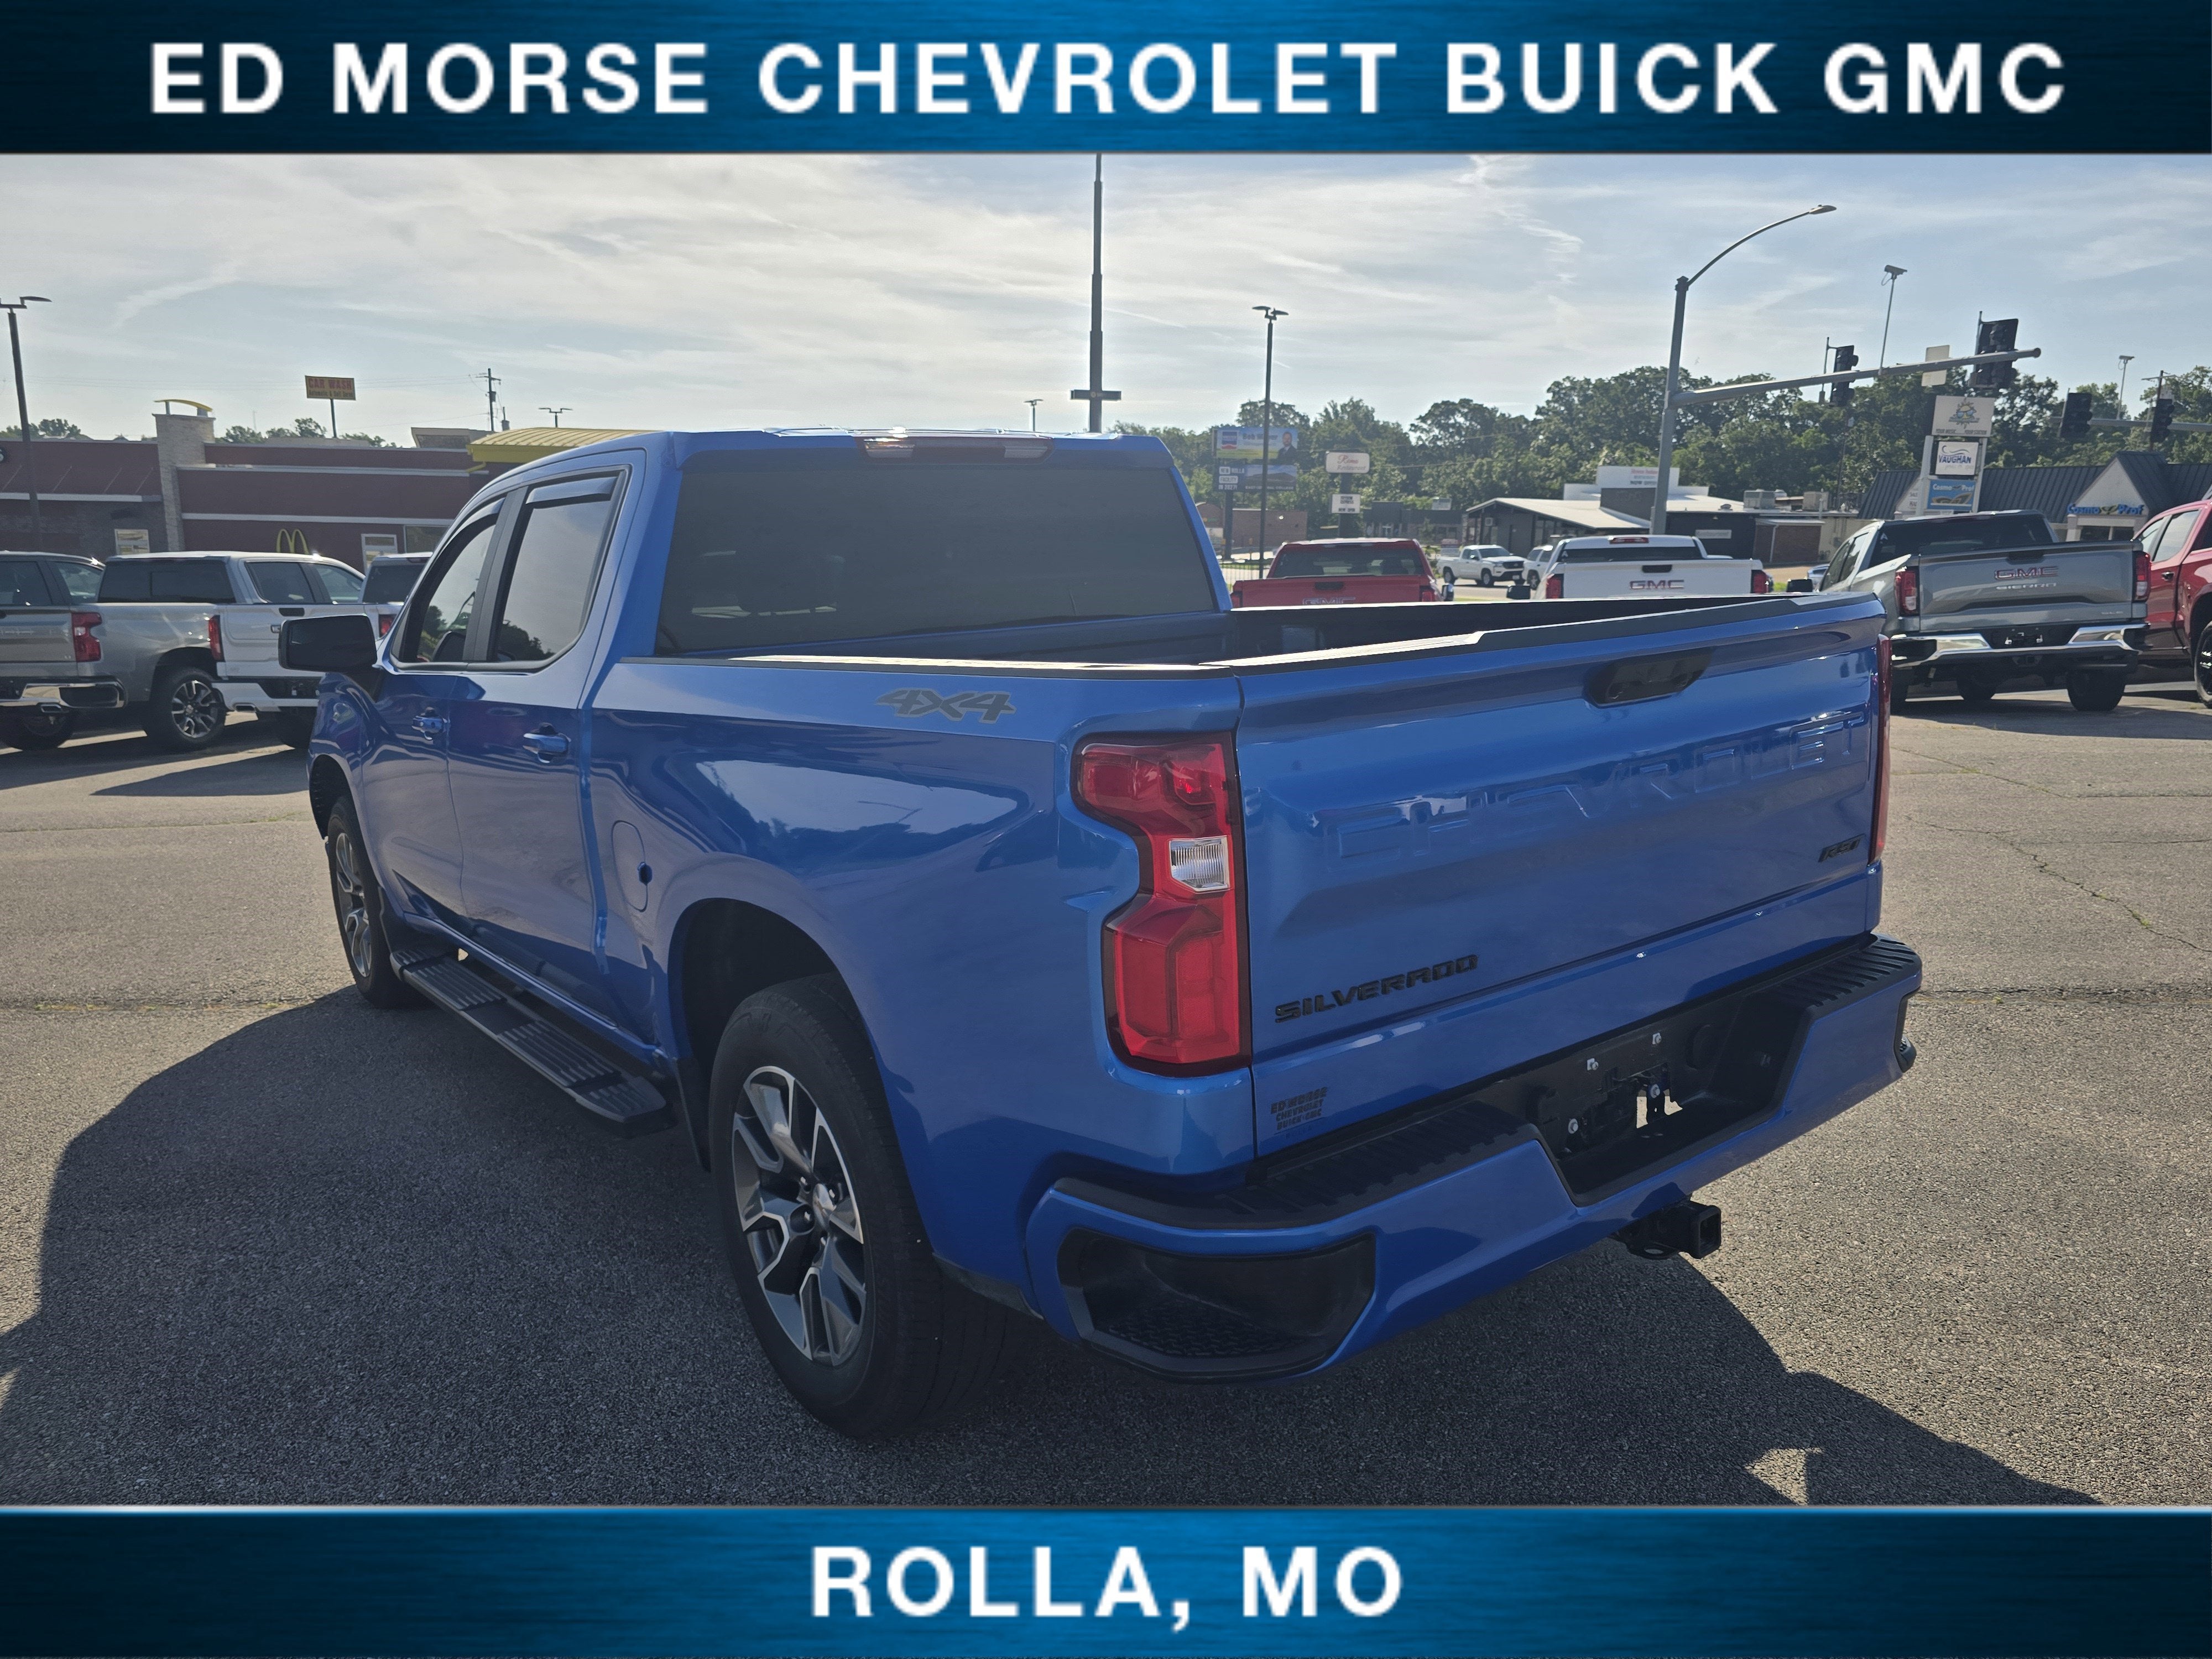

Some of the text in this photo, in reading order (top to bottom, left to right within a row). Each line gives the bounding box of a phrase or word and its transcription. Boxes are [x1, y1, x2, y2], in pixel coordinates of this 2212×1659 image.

[309, 378, 352, 390] CAR WASH
[1938, 455, 1972, 463] VAUGHAN
[2067, 503, 2145, 515] Cosmo Prof
[1994, 566, 2059, 580] GMC
[1629, 579, 1684, 590] GMC
[1818, 833, 1866, 863] RST
[1275, 953, 1479, 1024] SILVERADO
[1270, 1100, 1286, 1114] ED
[1276, 1098, 1324, 1122] CHEVROLET
